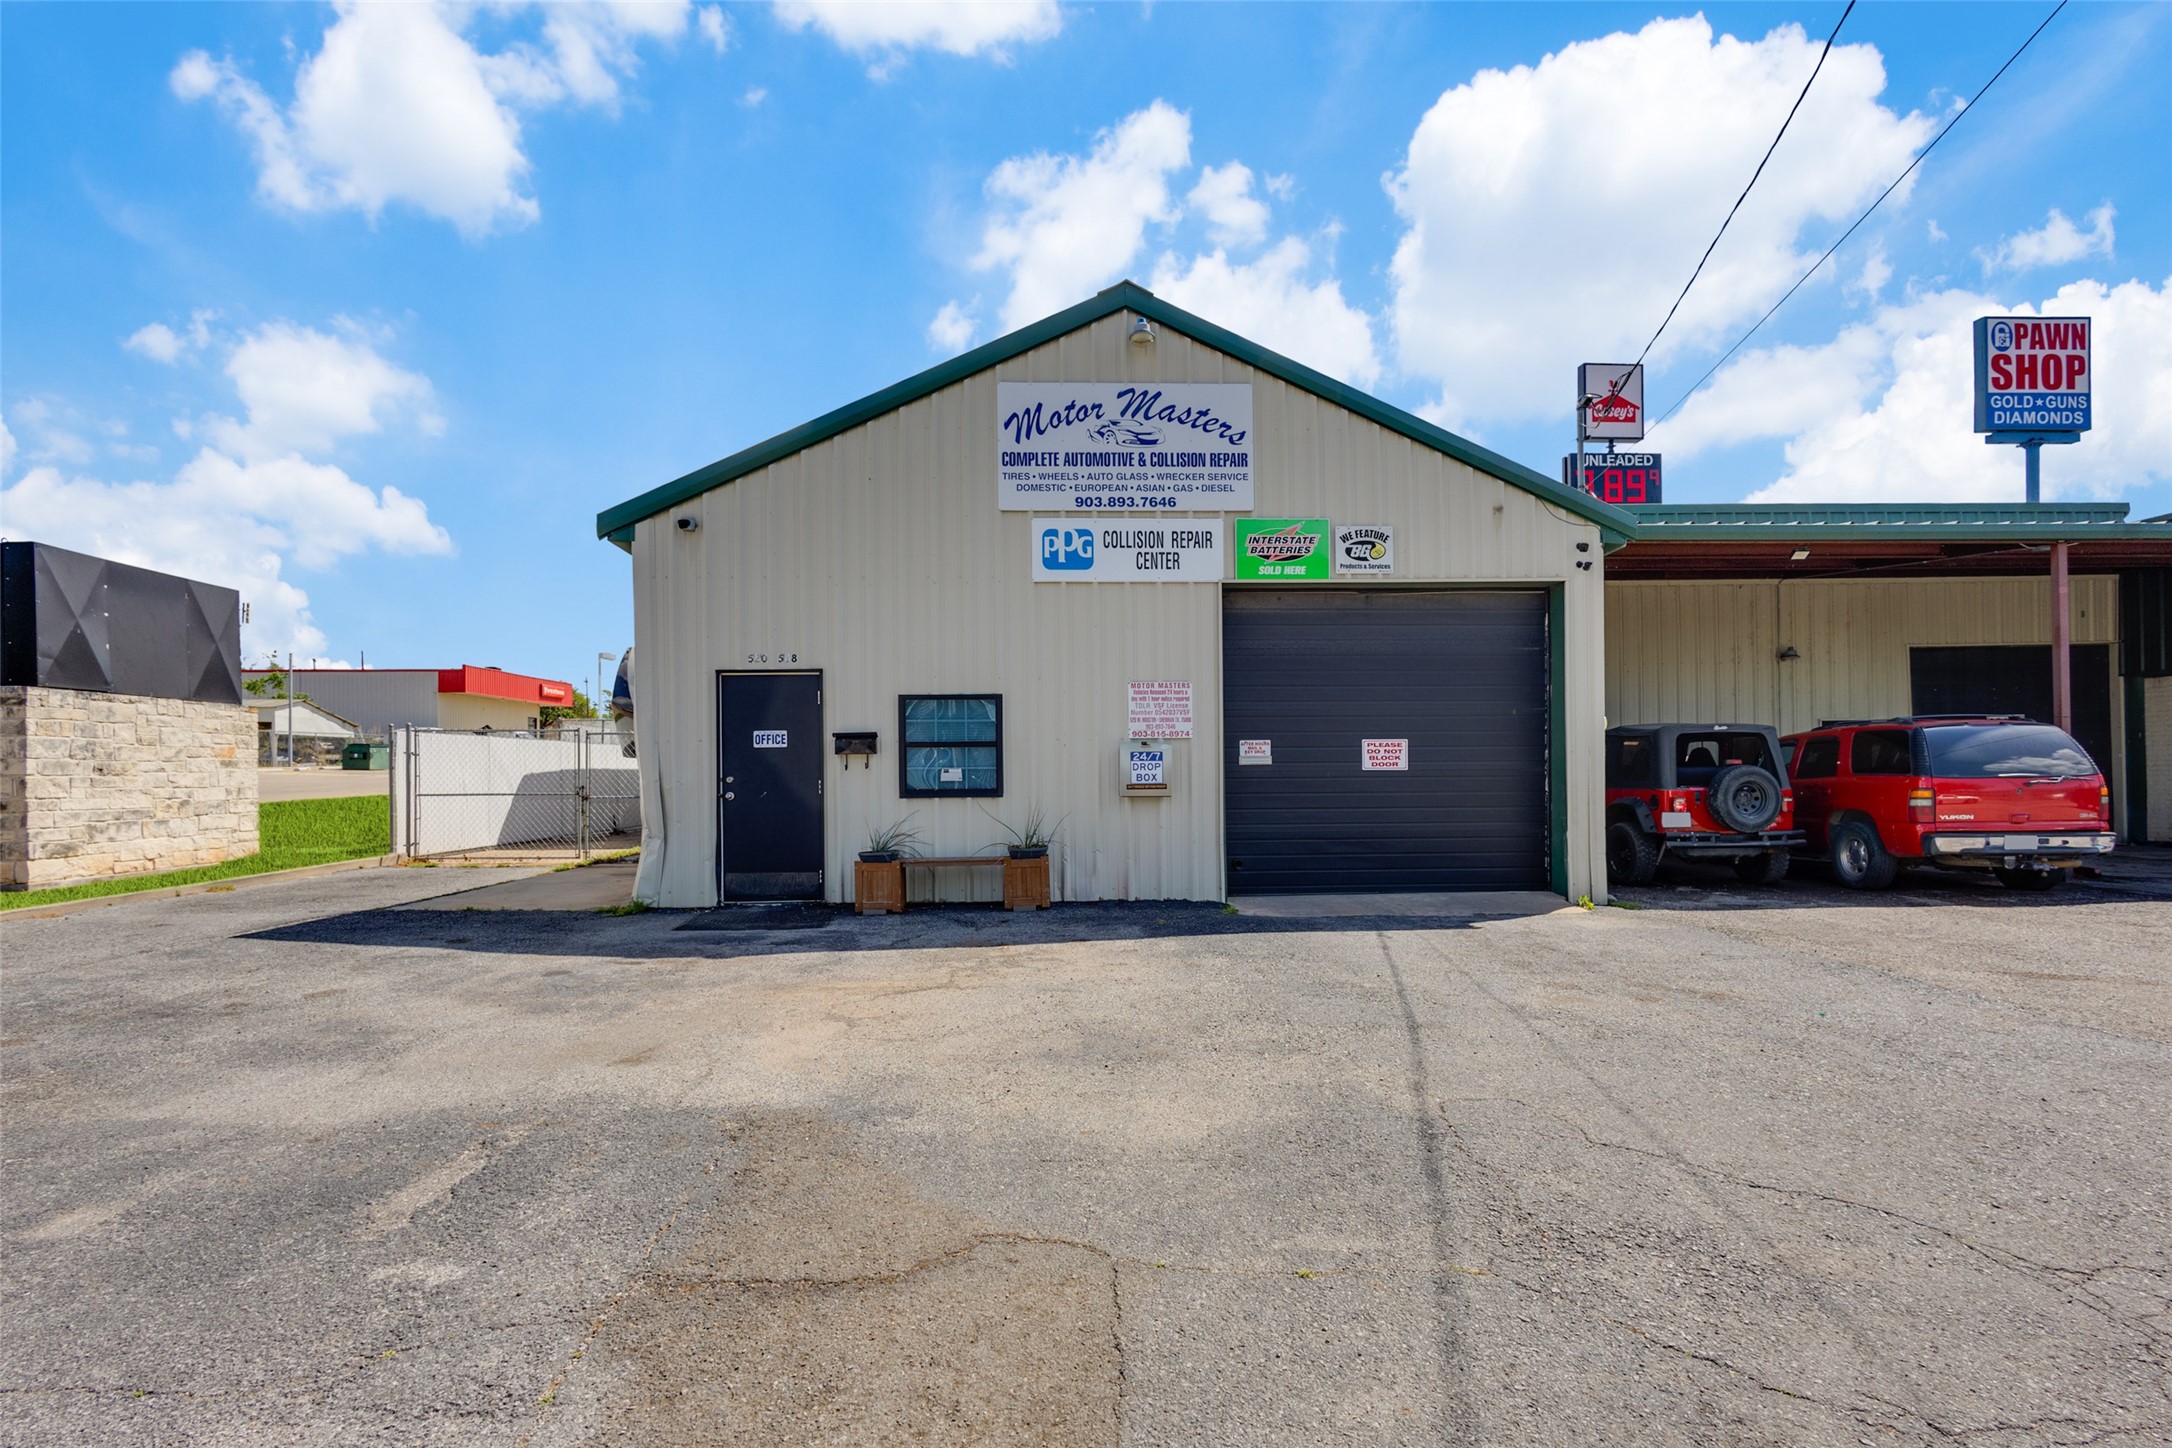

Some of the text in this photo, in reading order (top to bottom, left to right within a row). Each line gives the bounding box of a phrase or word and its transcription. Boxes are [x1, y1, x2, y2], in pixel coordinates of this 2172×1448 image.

[2014, 323, 2086, 350] PAWN
[1990, 353, 2086, 391] SHOP
[1990, 395, 2087, 409] GOLD GUNS
[1003, 387, 1247, 446] Motor Masters
[1994, 411, 2084, 425] DIAMONDS
[1001, 451, 1248, 468] COMPLETE AUTOMOTIVE & COLLISION REPAIR
[1002, 472, 1249, 481] TIRES WHEELS AUTO GLASS WRECKER SERVICE
[1016, 483, 1235, 492] DOMESTIC EUROPEAN ASIAN GAS DIESEL
[1074, 496, 1177, 508] 903.893.7646
[1103, 530, 1213, 549] COLLISION REPAIR
[1248, 536, 1316, 545] INTERSTATE
[1339, 529, 1390, 544] WE FEATURE
[1044, 528, 1093, 563] PPG
[1250, 546, 1311, 554] BATTERIES
[1350, 544, 1372, 557] BG
[1136, 551, 1180, 570] CENTER
[1258, 565, 1307, 575] SOLD HERE
[755, 734, 786, 745] OFFICE
[1132, 730, 1190, 738] 903-815-8974
[1132, 752, 1160, 761] 24/7
[1132, 762, 1161, 771] DROP
[1136, 773, 1157, 782] BOX
